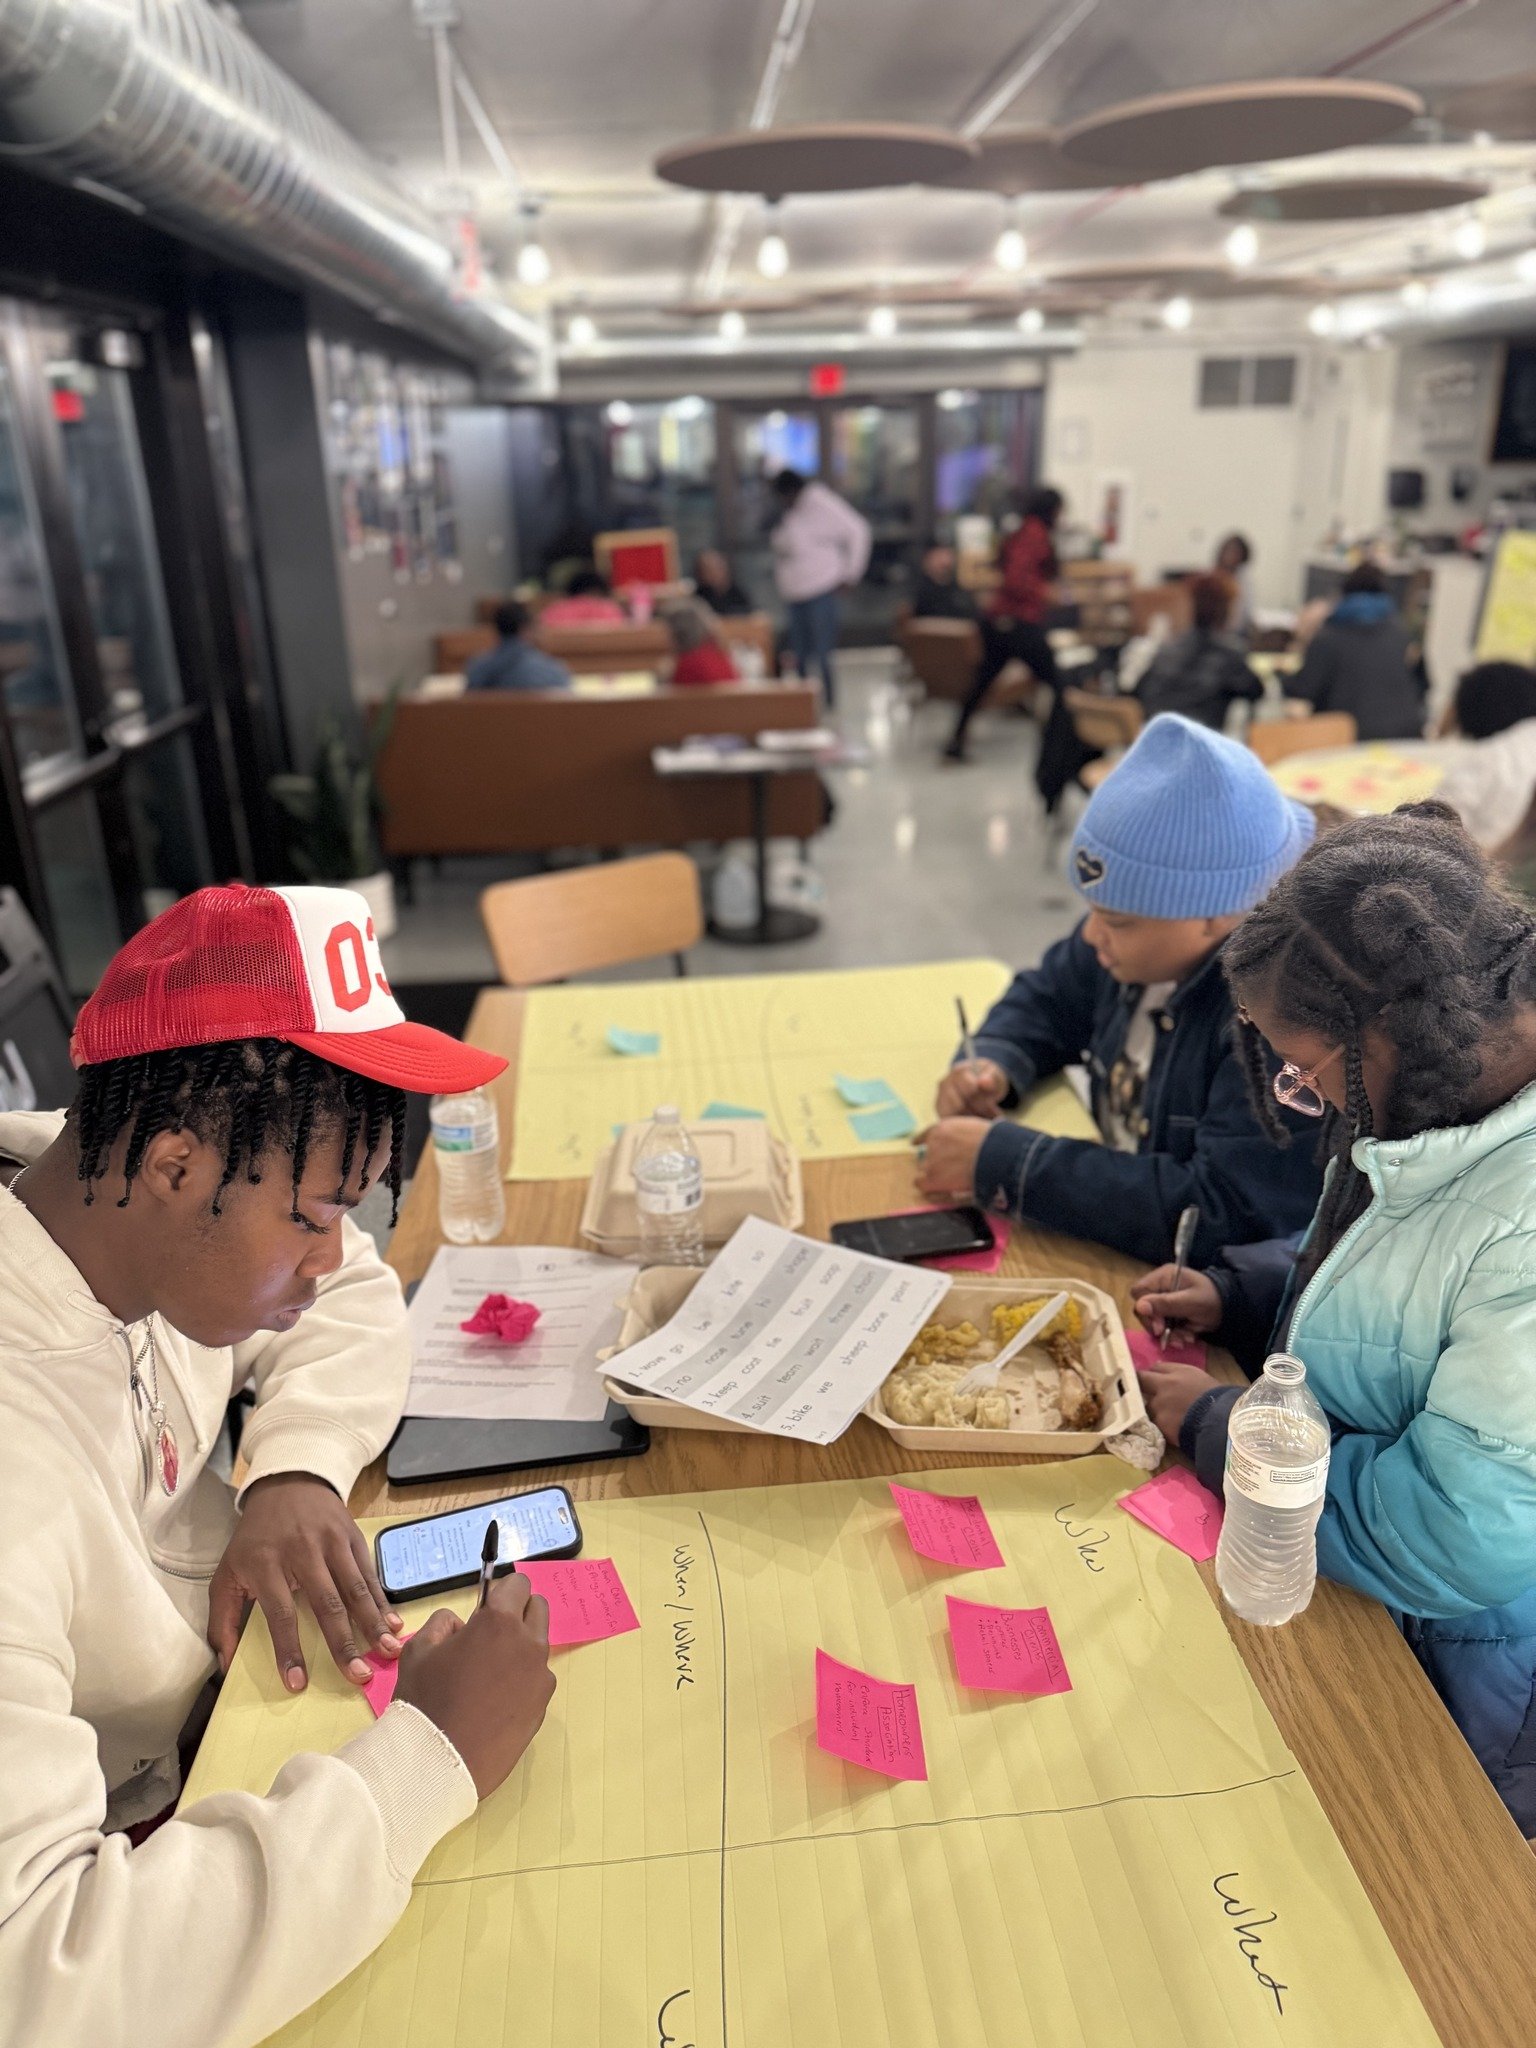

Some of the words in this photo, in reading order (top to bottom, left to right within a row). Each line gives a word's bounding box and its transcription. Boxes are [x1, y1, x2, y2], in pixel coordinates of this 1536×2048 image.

[324, 917, 391, 1012] 0
[639, 1355, 666, 1371] wave
[704, 1345, 729, 1366] nose
[707, 1379, 740, 1399] keep
[740, 1355, 762, 1376] coat
[750, 1392, 772, 1412] suit
[775, 1362, 800, 1386] team
[803, 1336, 823, 1358] wait
[784, 1401, 814, 1423] bike
[838, 1338, 869, 1367] sheep
[673, 1544, 695, 1597] When
[673, 1620, 696, 1691] Where
[1030, 1616, 1063, 1678] Commercial
[893, 1688, 914, 1759] Homeowners
[1214, 1872, 1288, 2016] What
